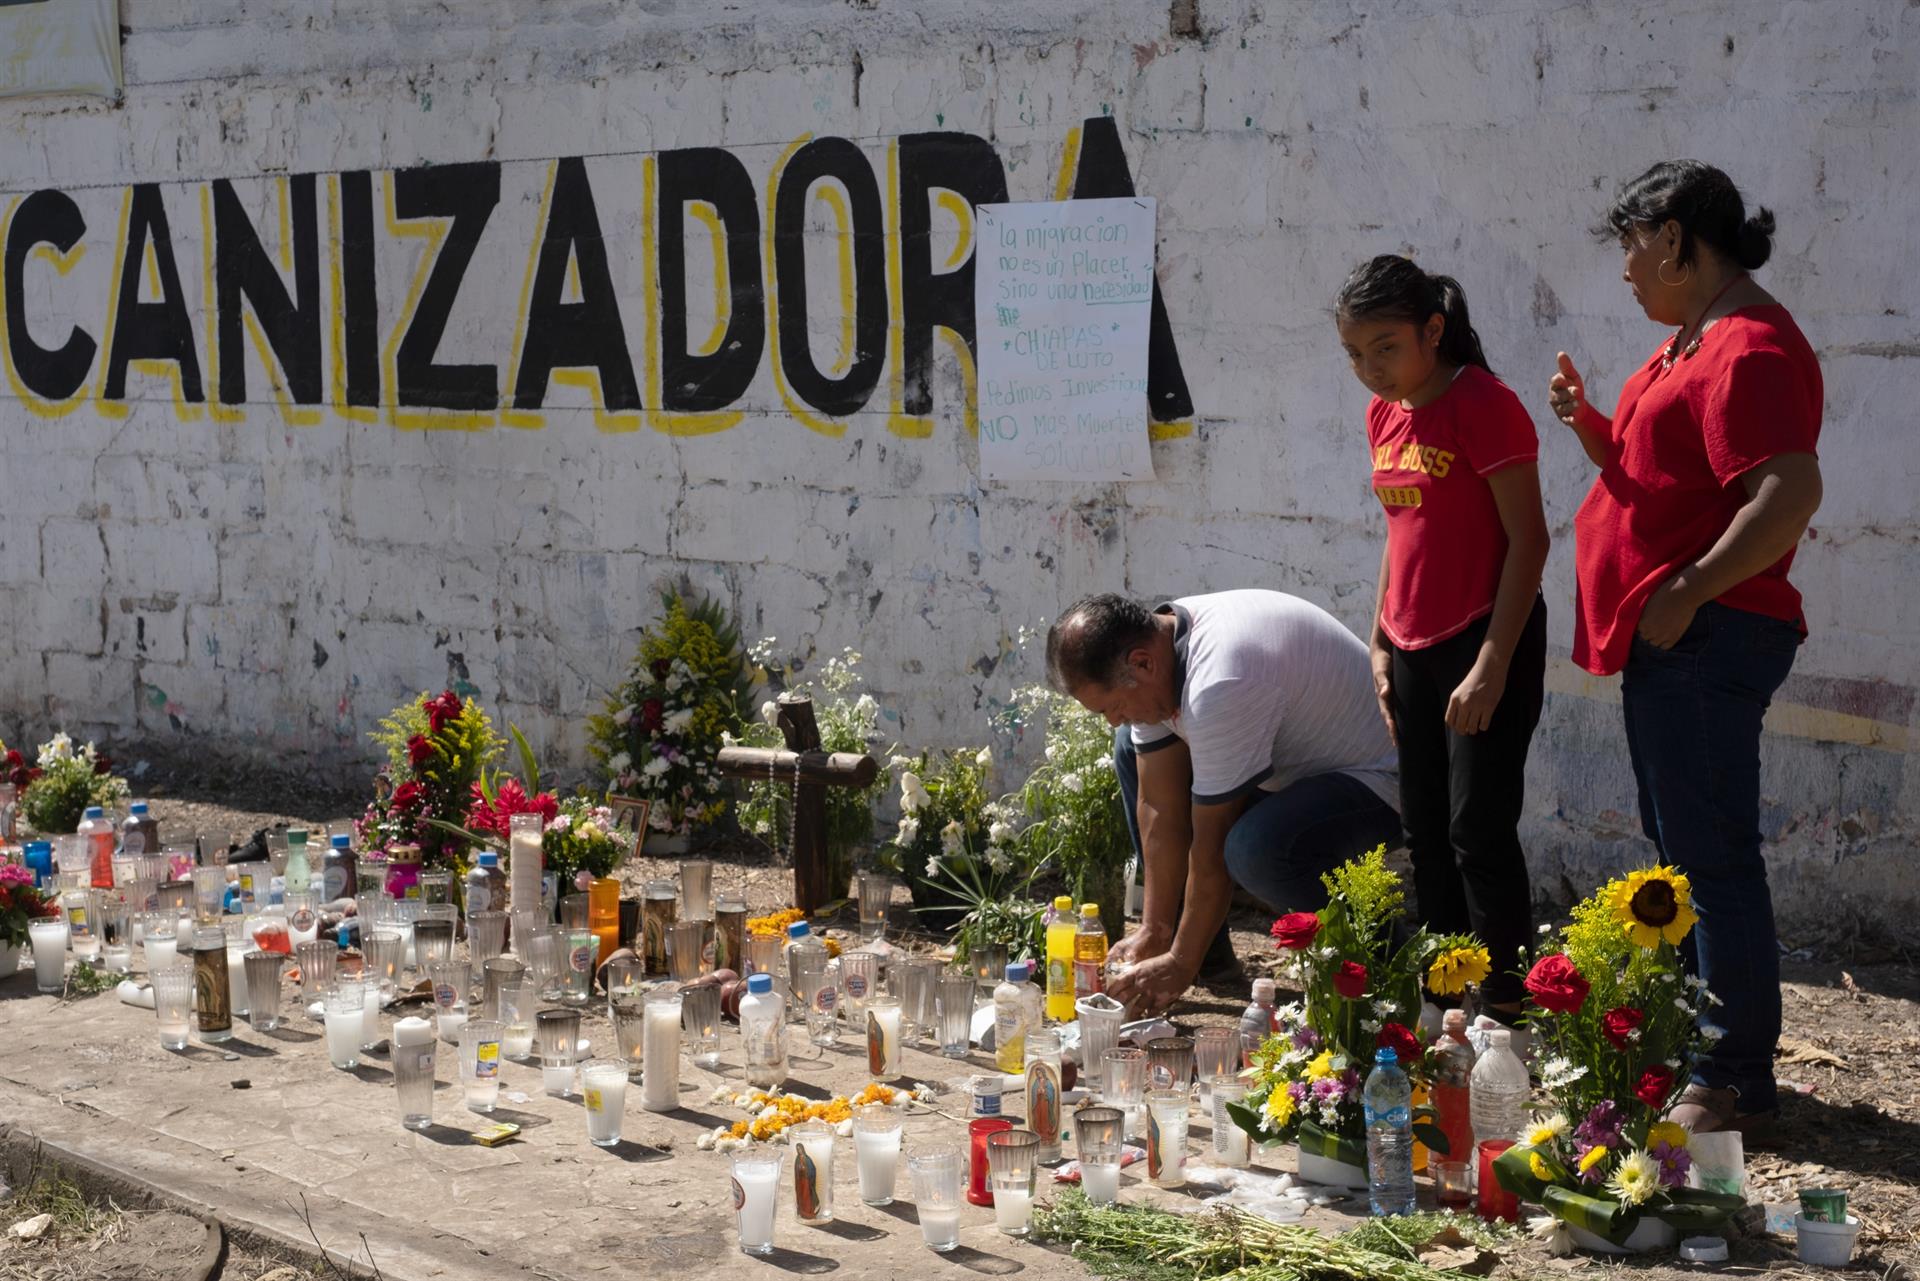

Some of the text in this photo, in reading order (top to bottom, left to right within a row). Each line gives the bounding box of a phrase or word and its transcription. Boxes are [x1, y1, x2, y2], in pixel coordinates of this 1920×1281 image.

[1048, 282, 1077, 300] una
[1036, 351, 1113, 371] DE LUTO
[979, 415, 1019, 448] NO
